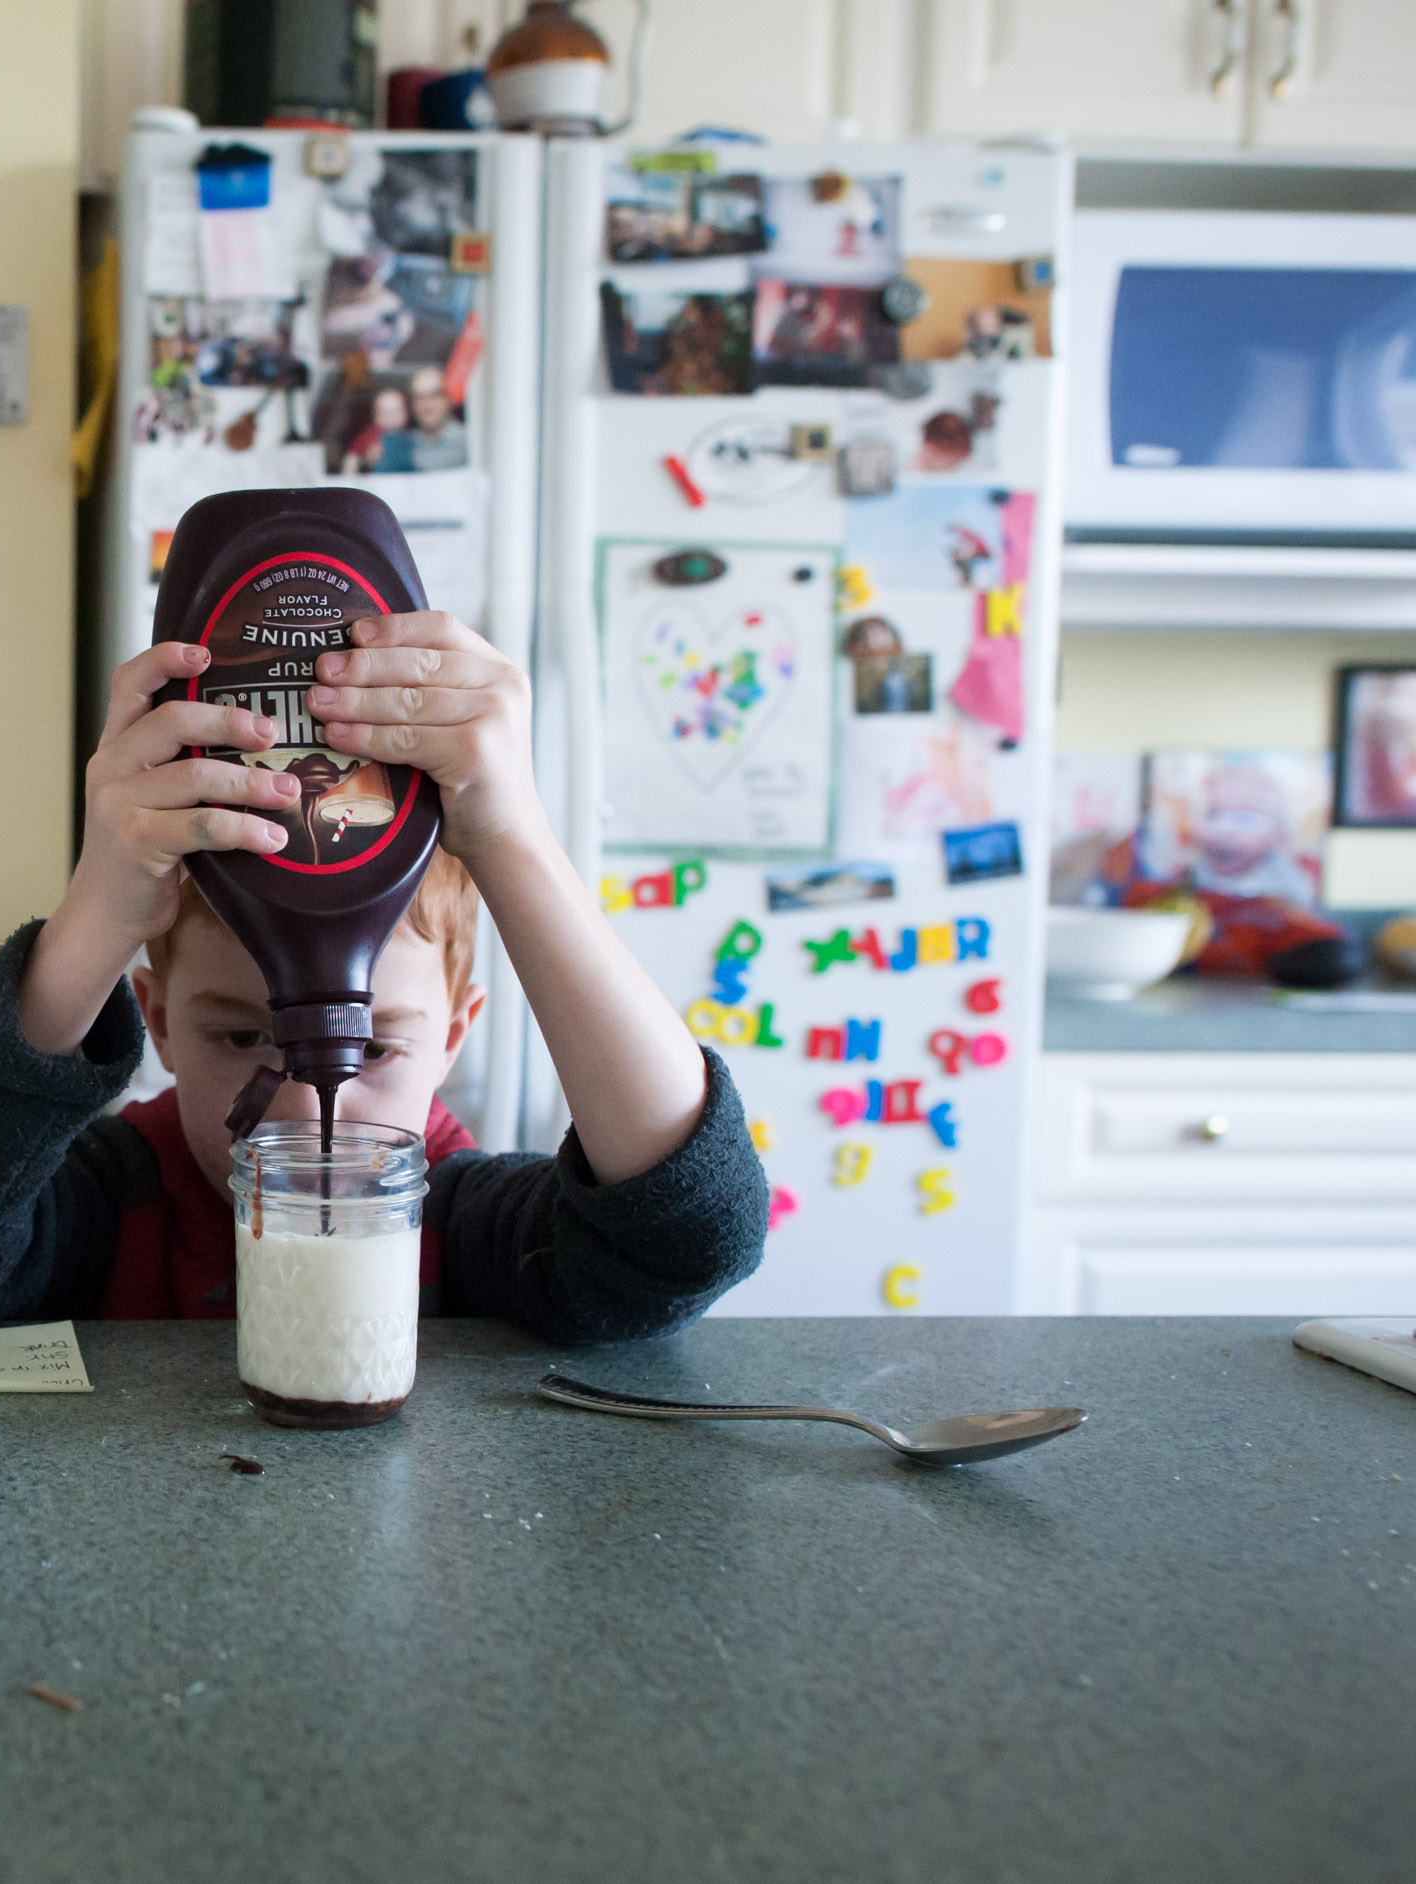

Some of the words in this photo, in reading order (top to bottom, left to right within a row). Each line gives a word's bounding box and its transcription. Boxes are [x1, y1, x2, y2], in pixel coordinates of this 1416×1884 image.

[270, 571, 284, 583] OZ)
[283, 569, 290, 580] 8
[289, 567, 299, 579] LB
[307, 568, 317, 579] OZ
[317, 570, 327, 582] 24
[326, 572, 337, 586] WT
[259, 577, 272, 590] 680
[337, 578, 350, 593] NET
[278, 595, 328, 605] FLAVOR
[264, 608, 343, 619] CHOCOLATE
[242, 624, 352, 648] ENUINE
[267, 660, 313, 677] RUP
[39, 1361, 71, 1371] Mix
